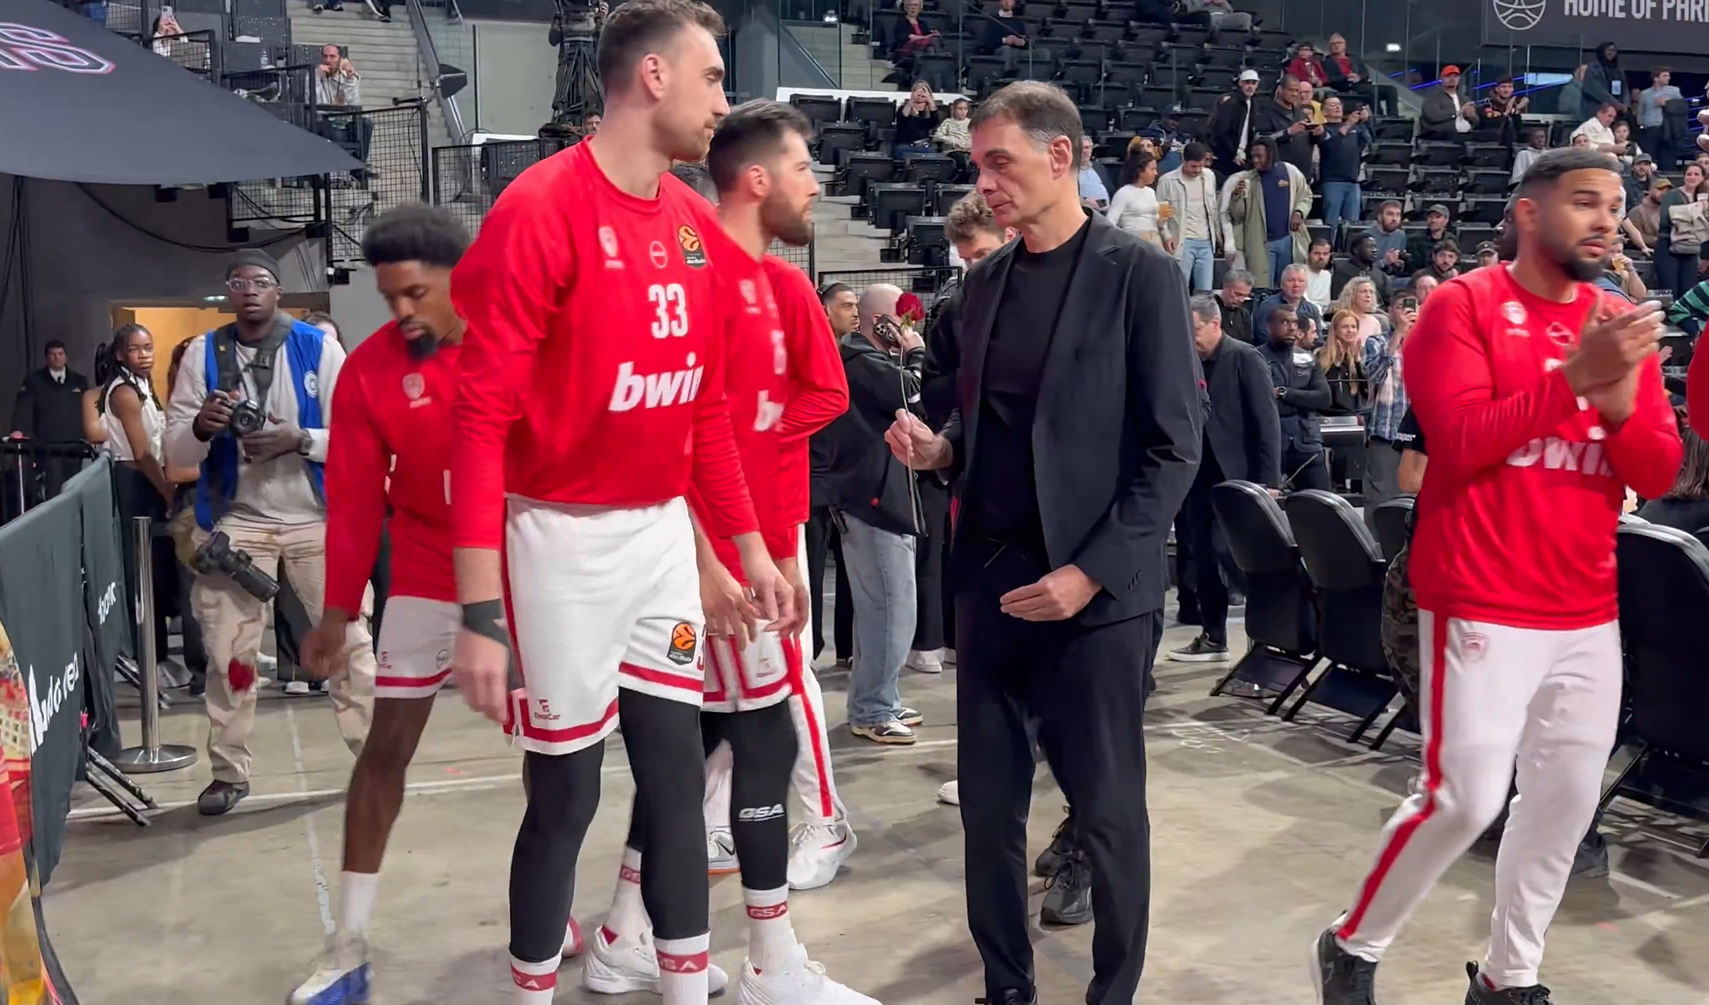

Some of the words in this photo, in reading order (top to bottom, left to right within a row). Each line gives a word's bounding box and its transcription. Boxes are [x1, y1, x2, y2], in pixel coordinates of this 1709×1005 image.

[1564, 0, 1627, 19] HOME
[1631, 0, 1657, 19] OF
[648, 283, 688, 339] 33
[739, 803, 785, 819] GSA
[750, 904, 788, 918] GSA
